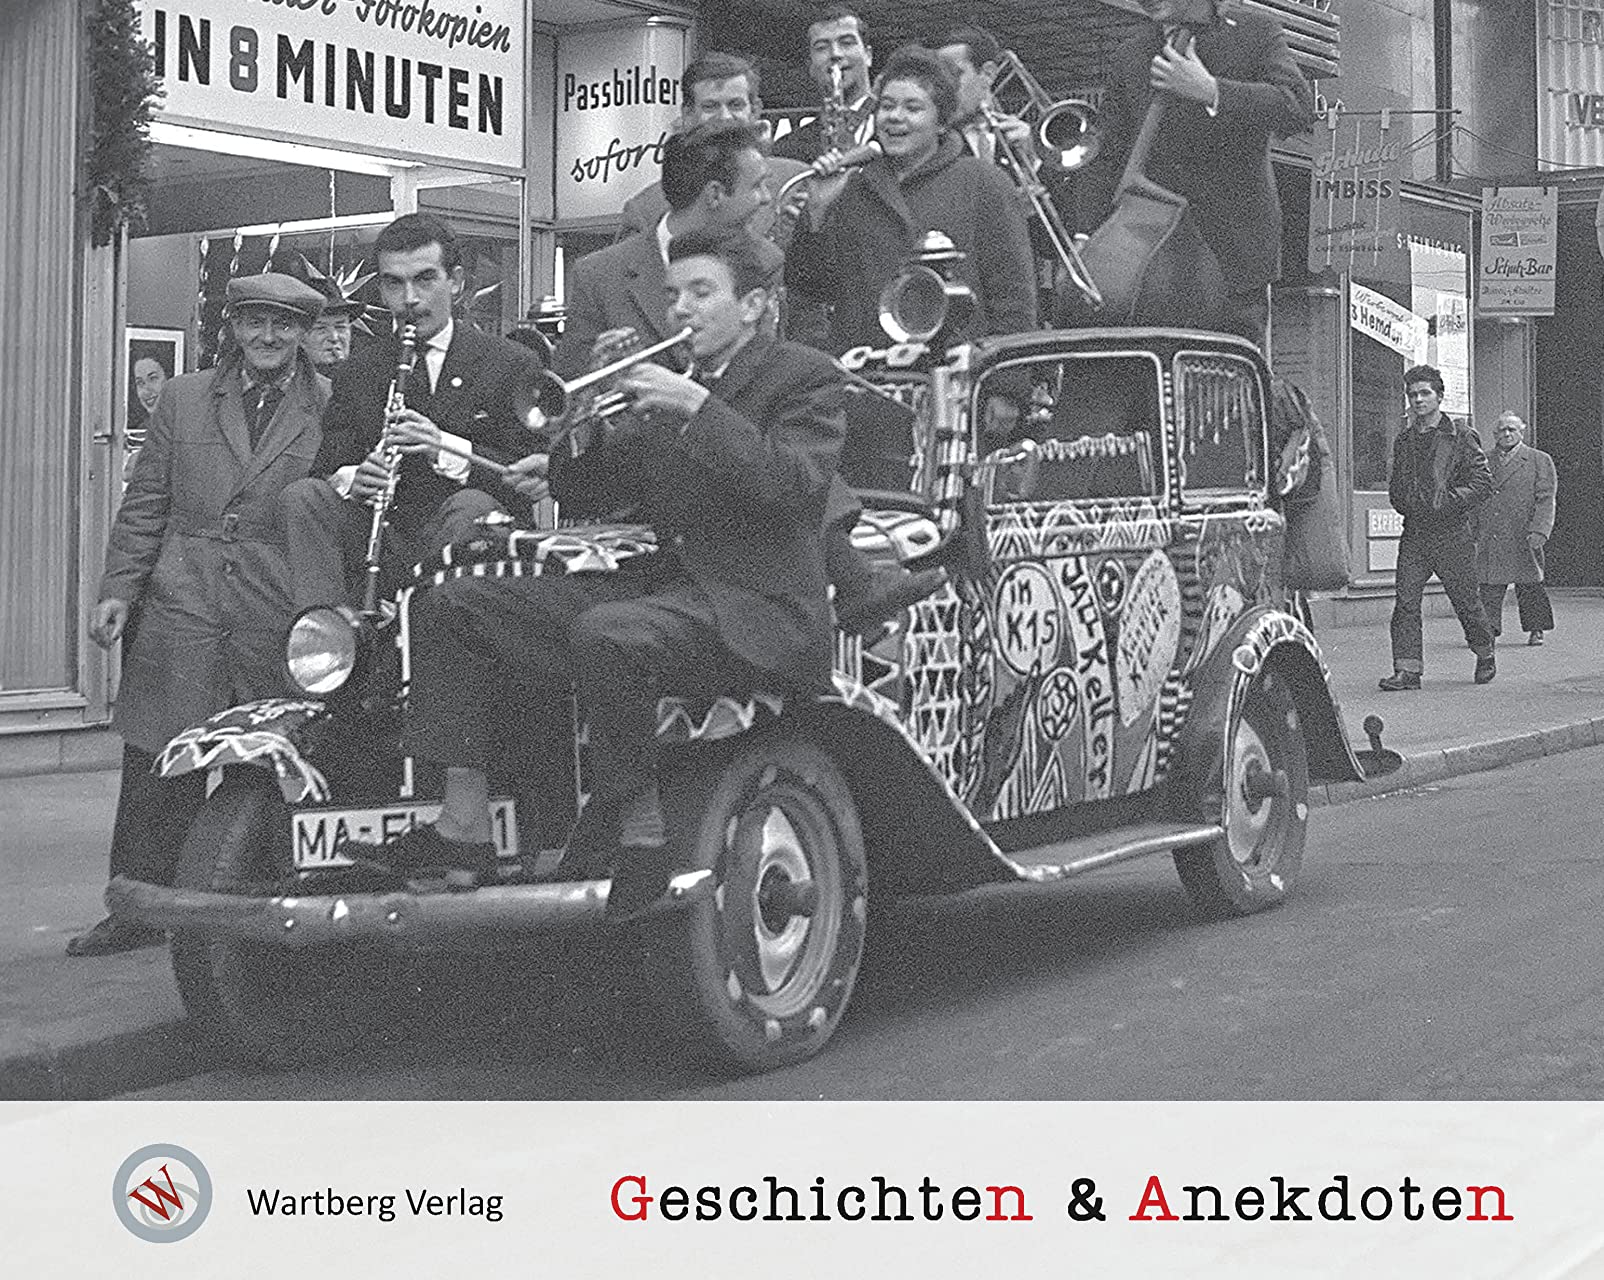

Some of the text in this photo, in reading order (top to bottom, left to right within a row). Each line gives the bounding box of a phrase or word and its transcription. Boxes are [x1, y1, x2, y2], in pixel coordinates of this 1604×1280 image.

[155, 9, 503, 136] IN 8 MINUTEN
[564, 65, 680, 113] Passbilder
[570, 131, 665, 184] sofort
[1315, 179, 1393, 200] IMBISS
